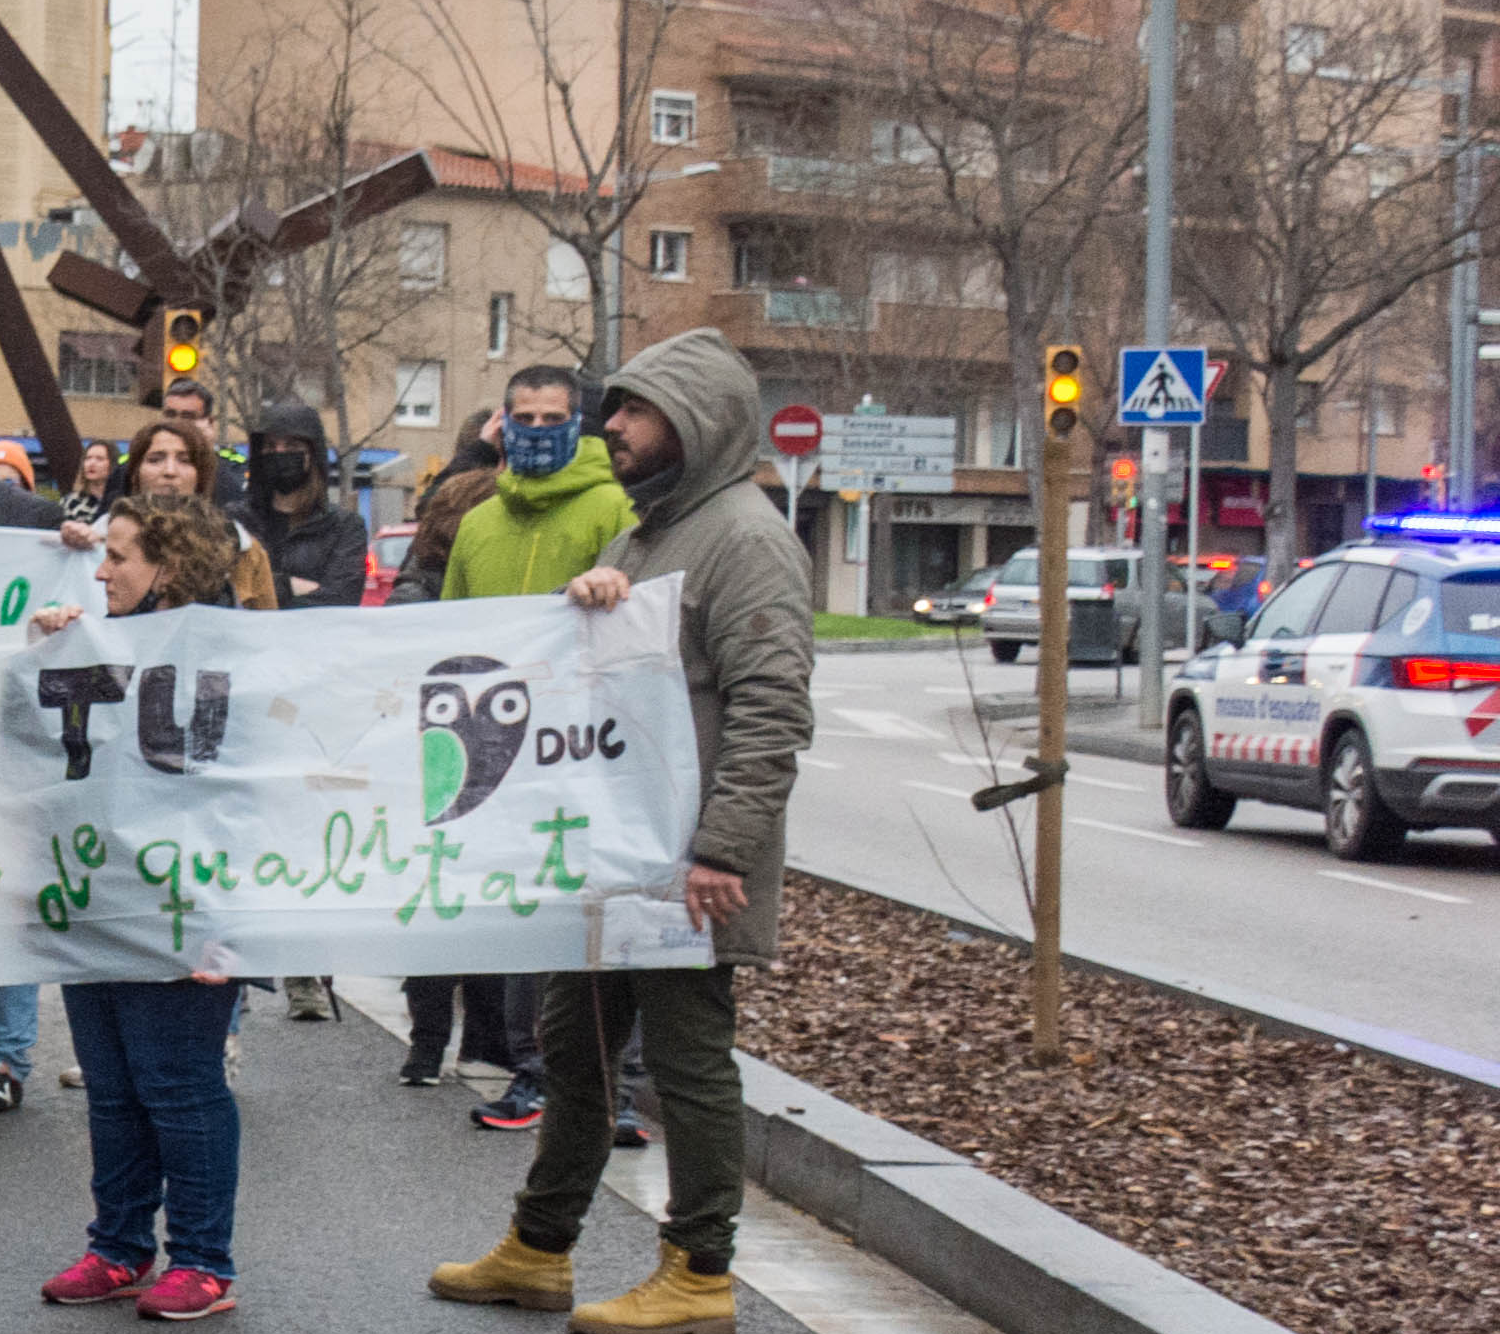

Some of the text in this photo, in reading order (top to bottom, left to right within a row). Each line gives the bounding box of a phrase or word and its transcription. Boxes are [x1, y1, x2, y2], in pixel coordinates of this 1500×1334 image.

[38, 663, 233, 781] TU
[536, 717, 627, 765] DUC
[37, 824, 107, 933] de
[135, 805, 590, 953] qualitat
